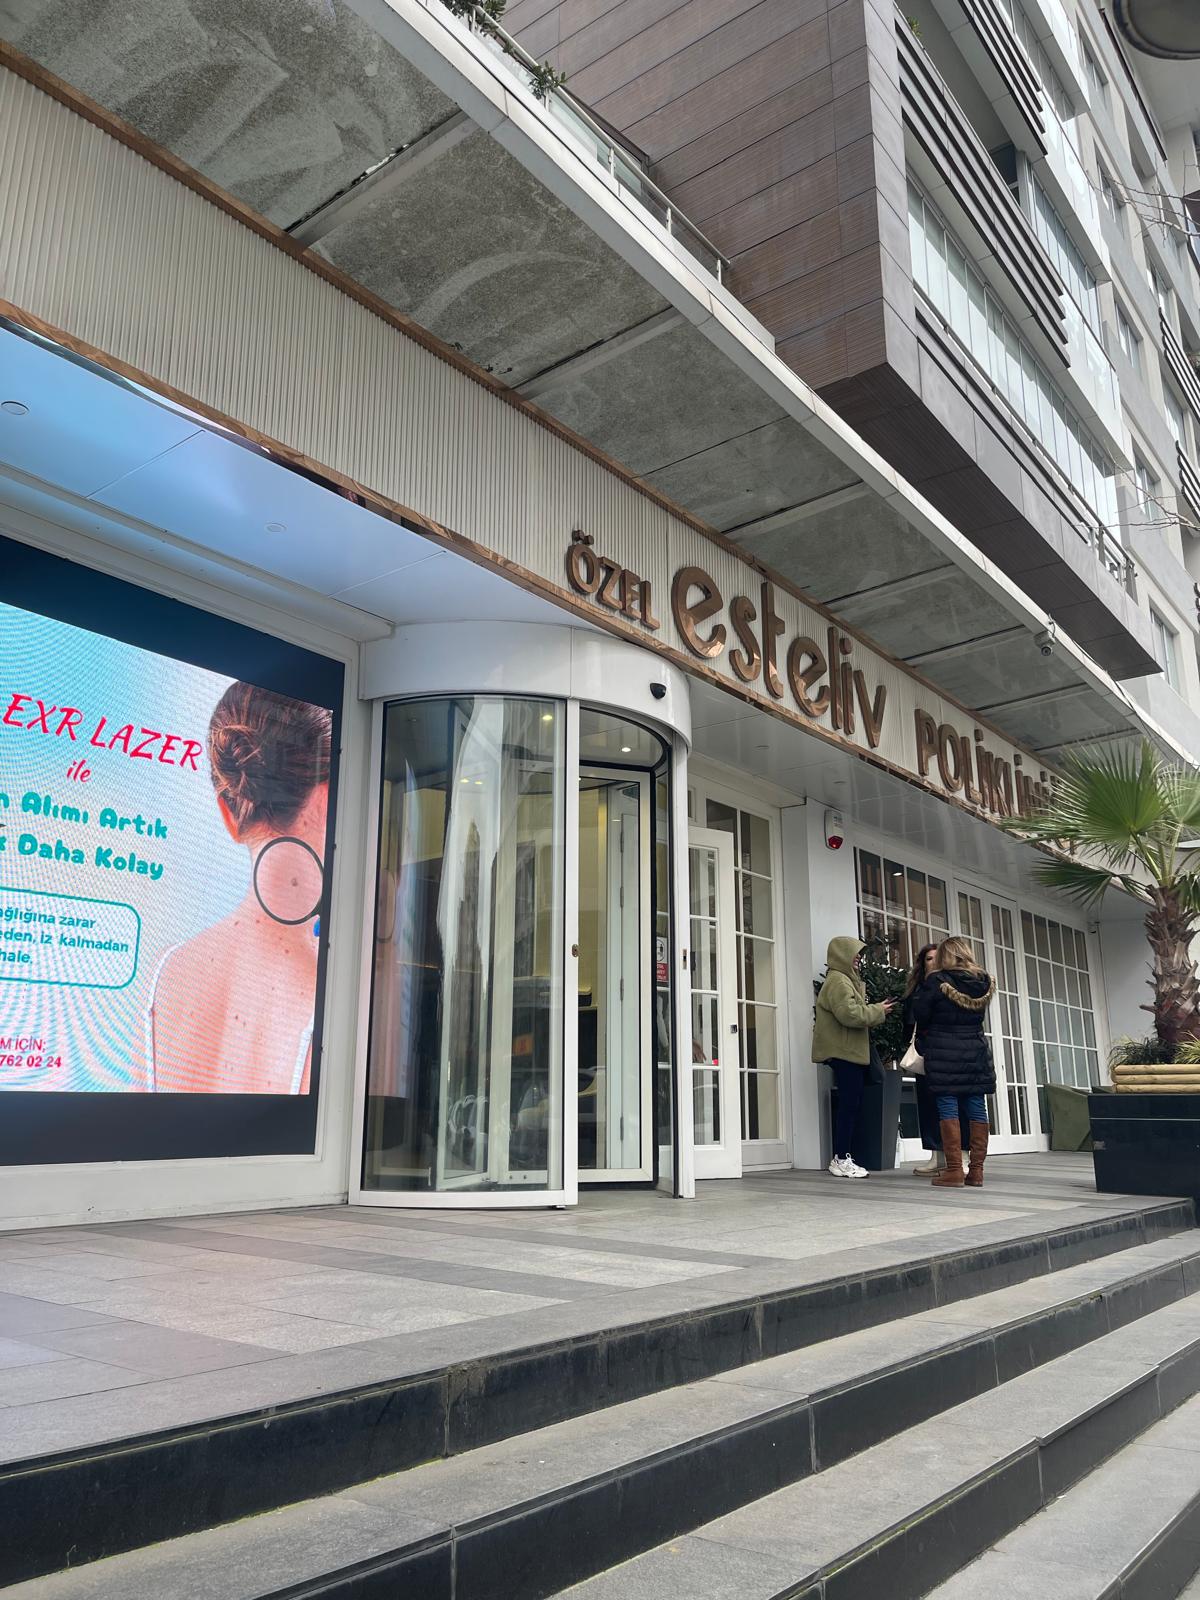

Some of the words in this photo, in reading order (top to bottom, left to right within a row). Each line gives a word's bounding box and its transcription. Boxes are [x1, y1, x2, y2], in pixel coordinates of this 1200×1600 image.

[566, 529, 660, 630] ÖZEL
[671, 566, 886, 748] esteliv
[2, 693, 84, 741] EXR
[90, 716, 203, 771] LAZER
[66, 759, 92, 783] ile
[21, 791, 89, 825] Alımı
[99, 807, 168, 840] Artık
[18, 833, 85, 865] Daha
[95, 846, 164, 881] Kolay
[59, 915, 96, 929] zarar
[40, 931, 53, 945] iz
[59, 933, 129, 953] kalmadan
[26, 1055, 43, 1068] 02
[46, 1056, 62, 1068] 24
